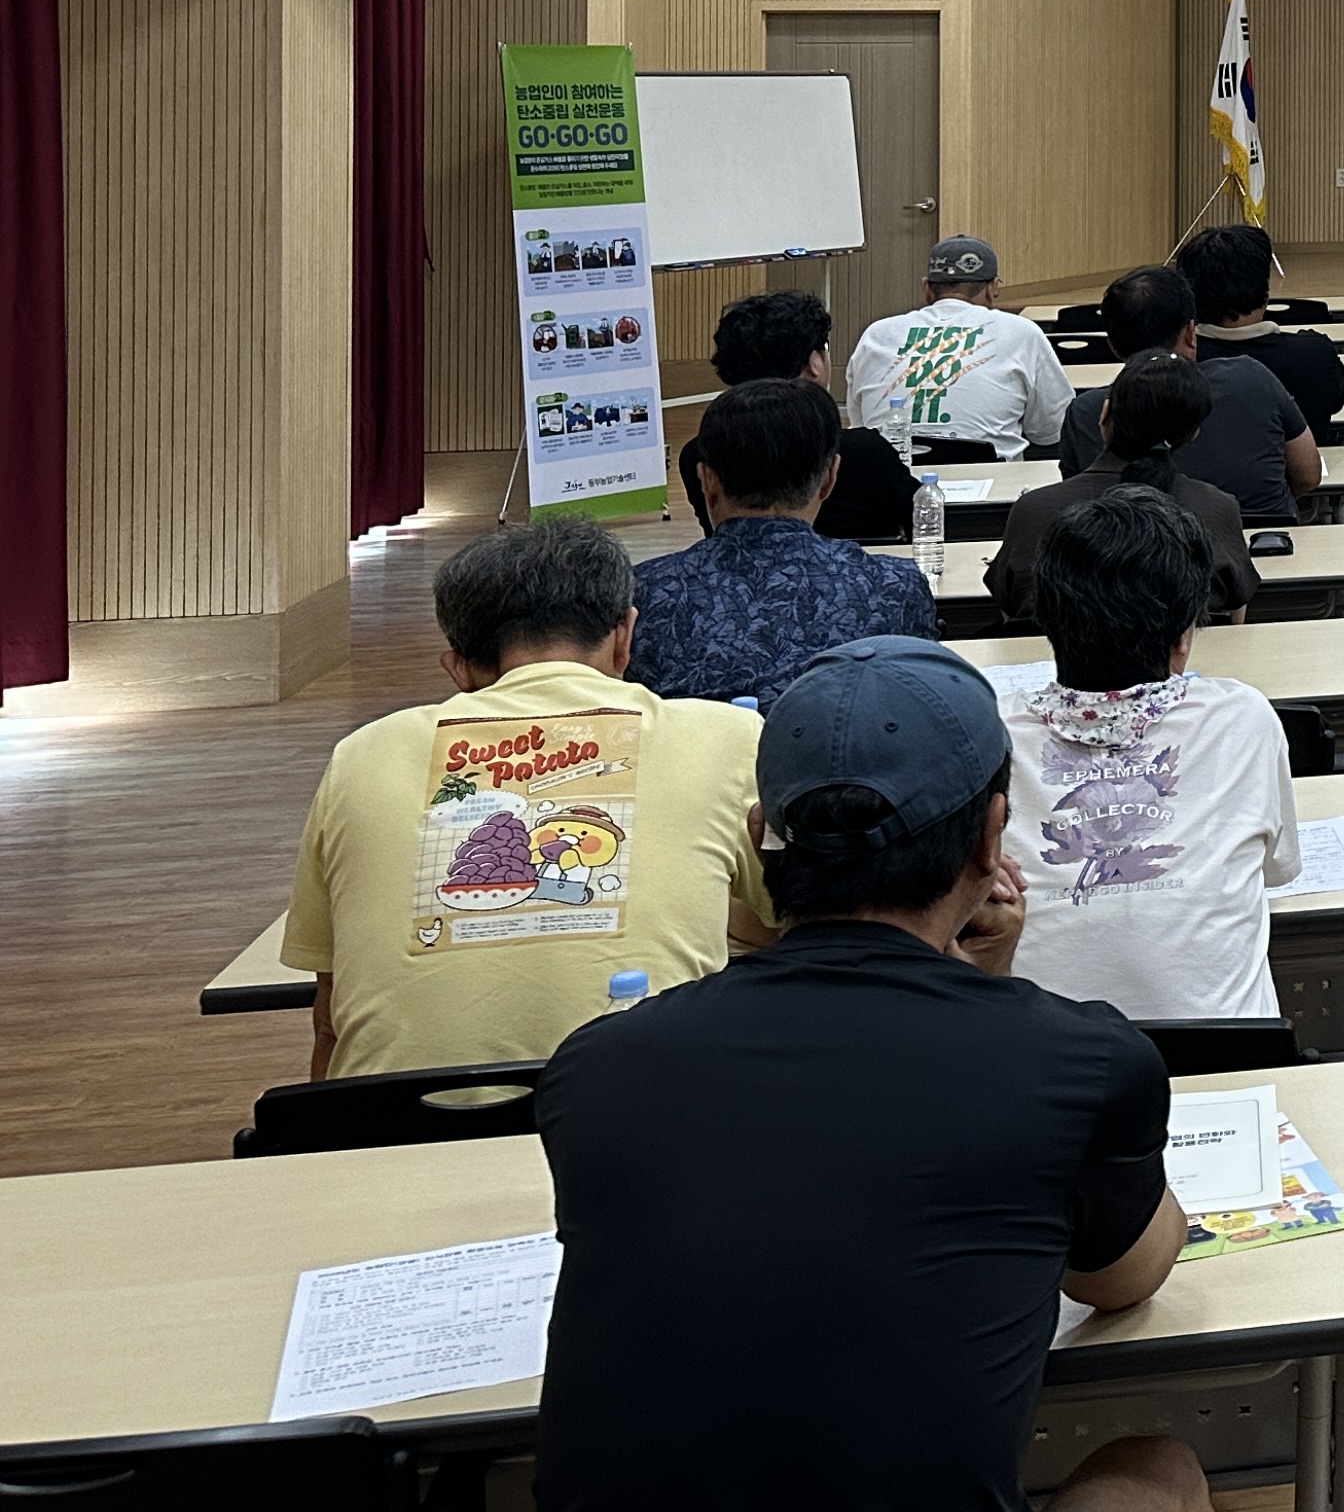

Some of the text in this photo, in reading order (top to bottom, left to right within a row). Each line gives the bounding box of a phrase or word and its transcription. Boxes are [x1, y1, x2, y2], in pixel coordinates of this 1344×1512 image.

[515, 84, 623, 101] 농업인이 참여하는
[517, 103, 625, 120] 탄소중립 실천운동
[897, 326, 984, 356] JUST
[905, 355, 962, 388] DO
[911, 388, 952, 424] IT.
[446, 725, 546, 772] Sweet
[486, 741, 600, 788] Potato
[1062, 762, 1172, 785] EPHEMERA
[464, 797, 496, 806] FRESH
[1055, 803, 1174, 832] COLLECTOR
[1105, 847, 1124, 859] BY
[1123, 878, 1184, 892] INSIDER
